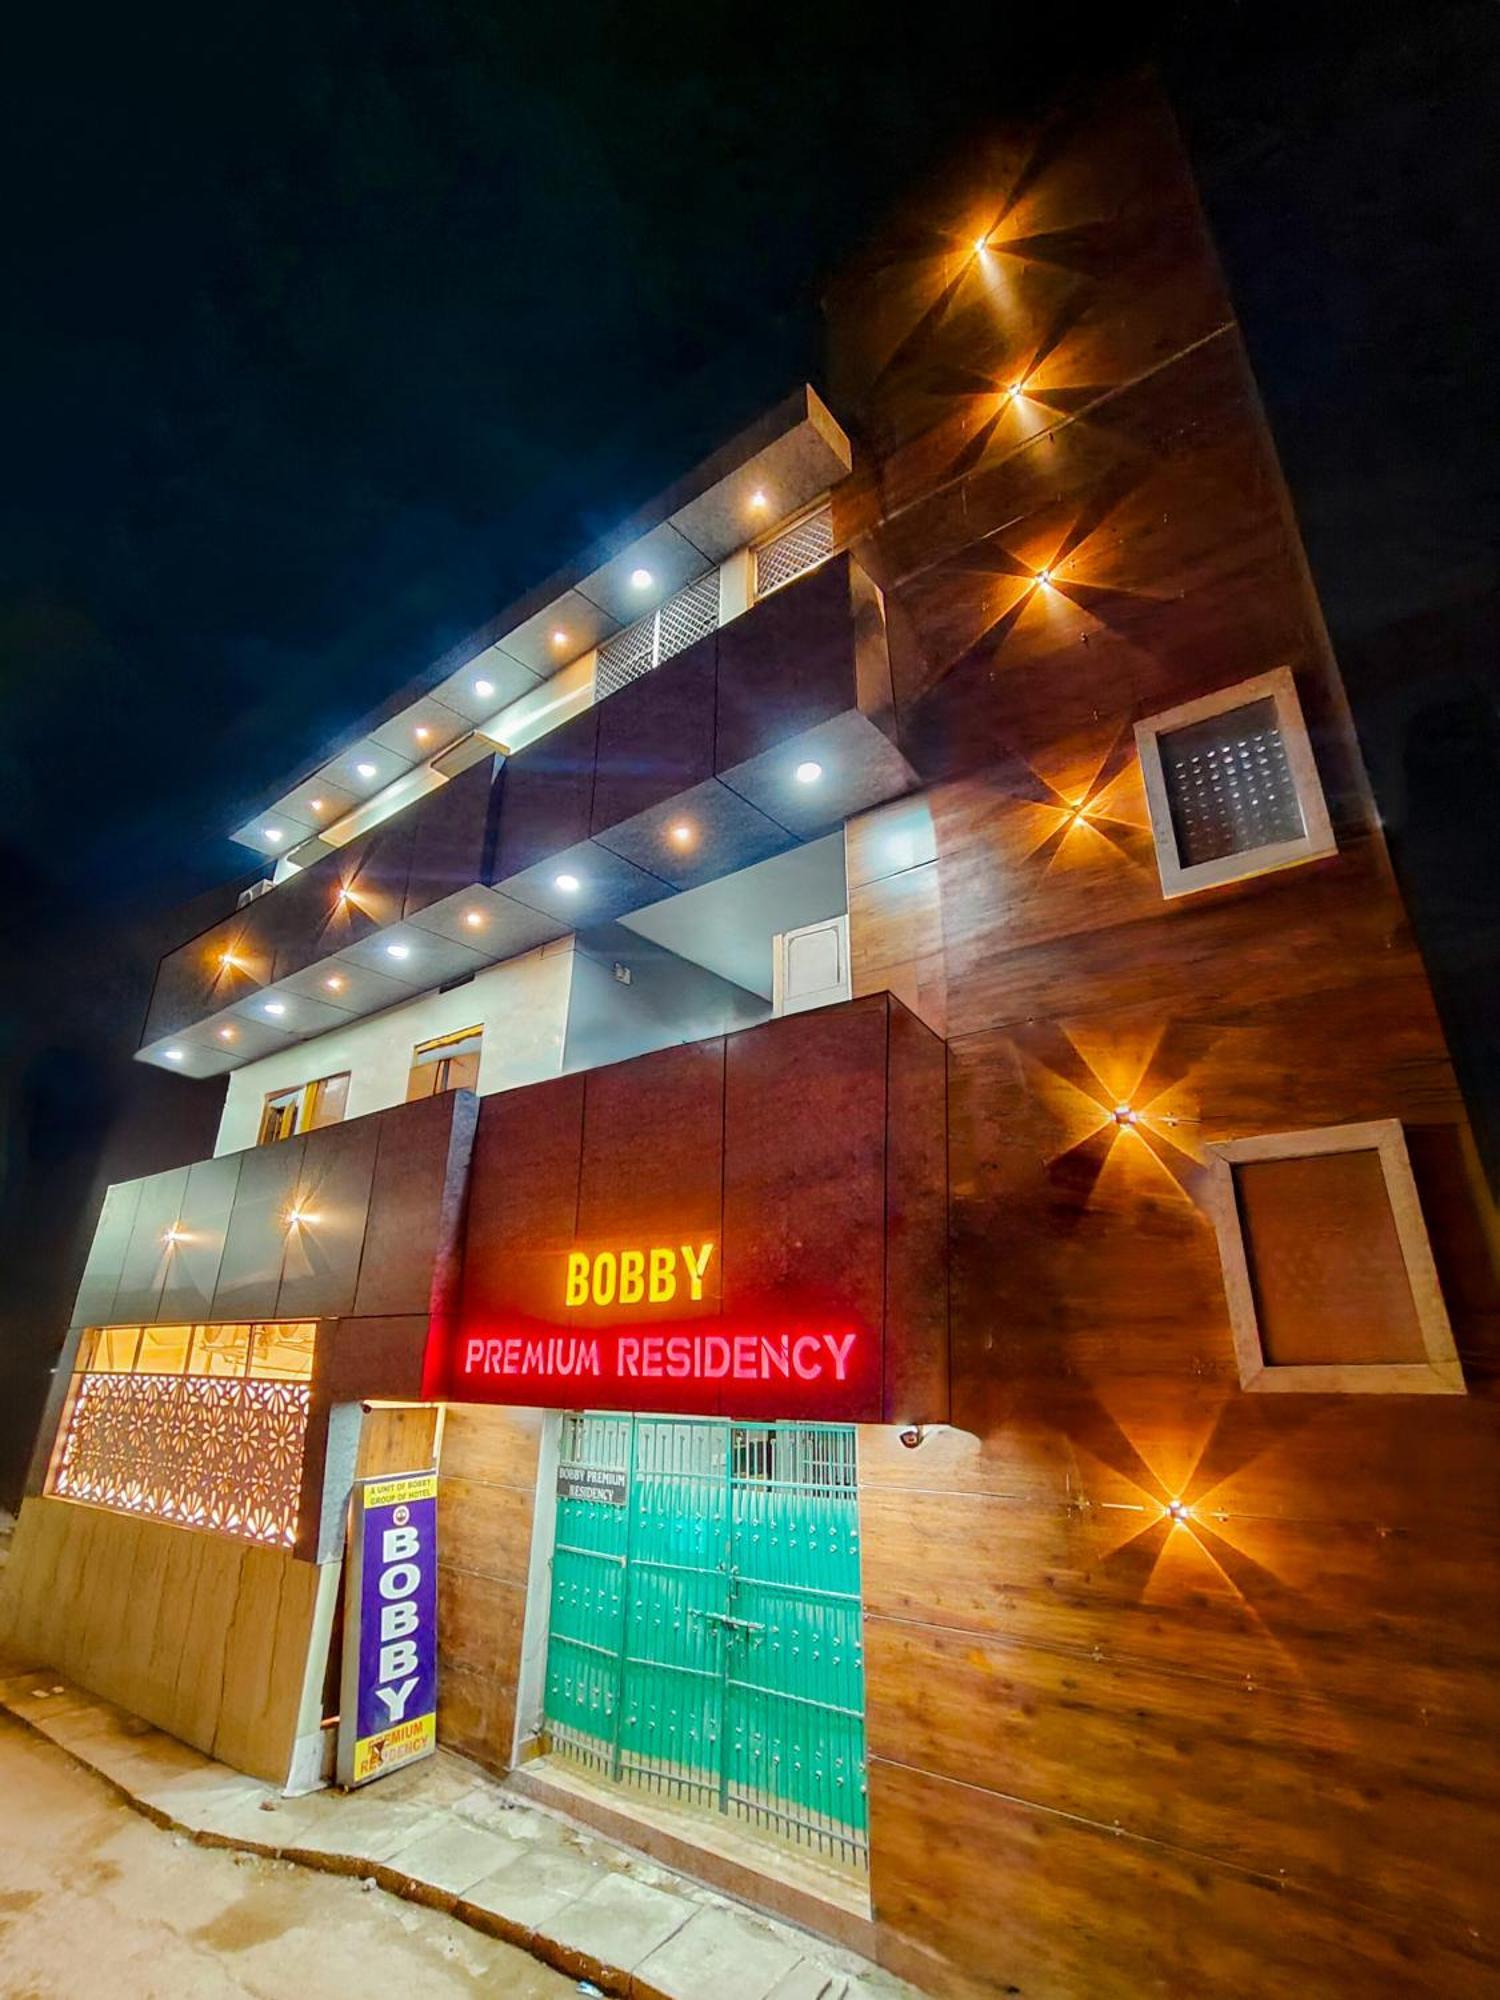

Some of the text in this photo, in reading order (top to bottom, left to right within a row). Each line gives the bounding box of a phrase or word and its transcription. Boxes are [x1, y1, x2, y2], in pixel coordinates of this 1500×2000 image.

[565, 1243, 714, 1307] BOBBY
[464, 1332, 857, 1381] PREMIUM RESIDENCY
[559, 1467, 625, 1487] BOBBY PREMIUM
[569, 1484, 614, 1501] RESIDENCY
[375, 1525, 421, 1724] BOBBY
